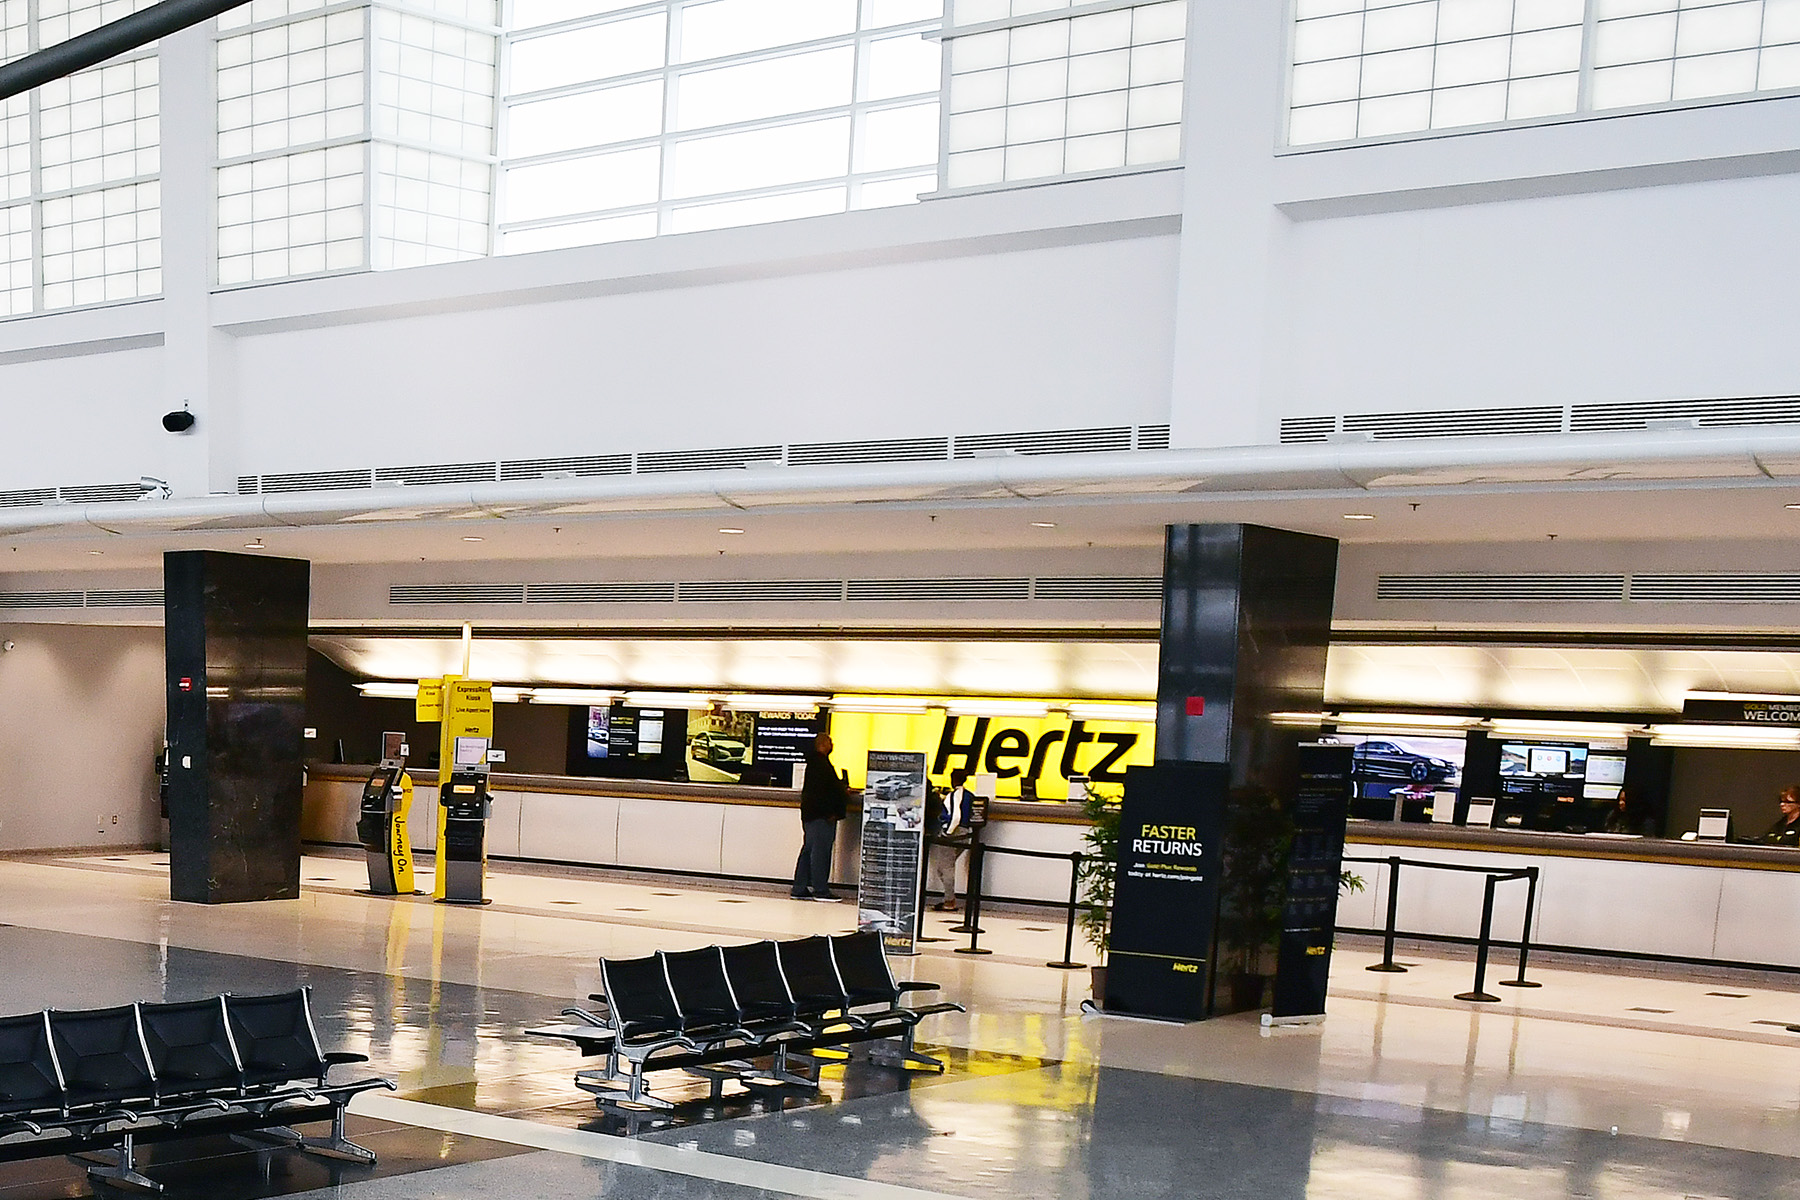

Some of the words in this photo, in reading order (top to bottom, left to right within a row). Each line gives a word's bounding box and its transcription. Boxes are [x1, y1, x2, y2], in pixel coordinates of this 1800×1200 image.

[1743, 703, 1768, 711] GOLD
[932, 716, 1141, 784] Hertz
[393, 816, 405, 856] Journey
[1141, 824, 1196, 840] FASTER
[1132, 839, 1203, 857] RETURNS
[397, 858, 408, 875] On.
[1172, 962, 1199, 973] Hertz
